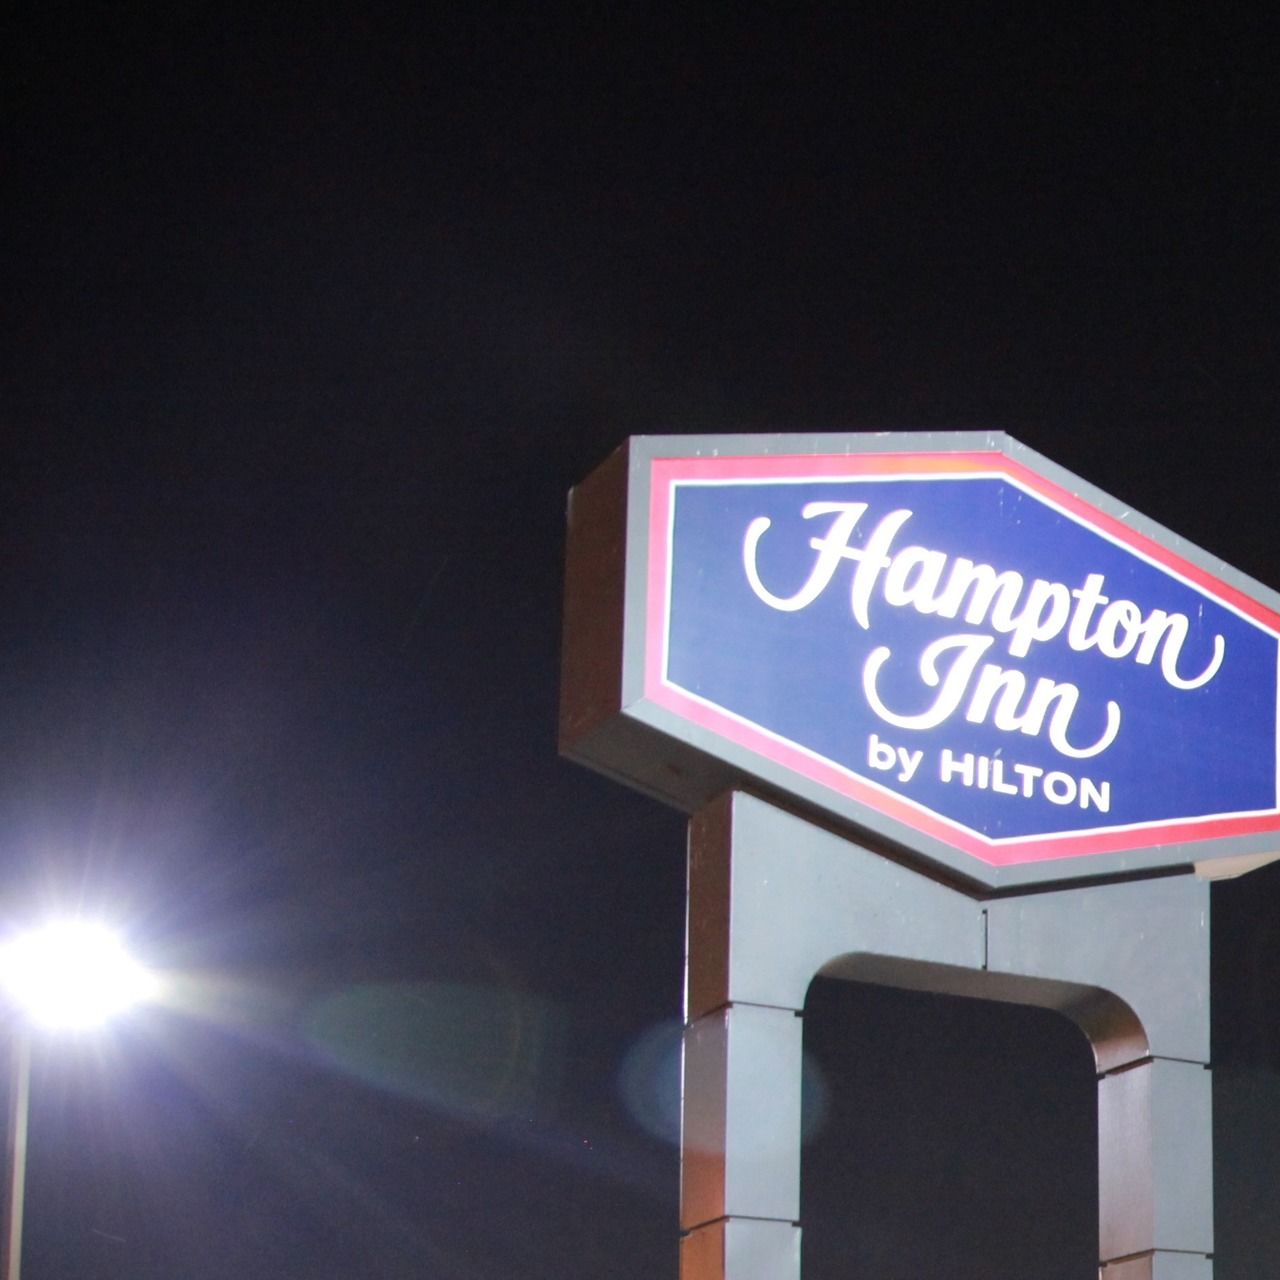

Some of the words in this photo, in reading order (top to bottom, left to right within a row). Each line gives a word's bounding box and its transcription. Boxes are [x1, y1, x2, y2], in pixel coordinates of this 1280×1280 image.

[742, 500, 1226, 691] Hampton
[861, 632, 1121, 760] Inn
[866, 733, 924, 783] by
[939, 748, 1111, 813] HILTON
